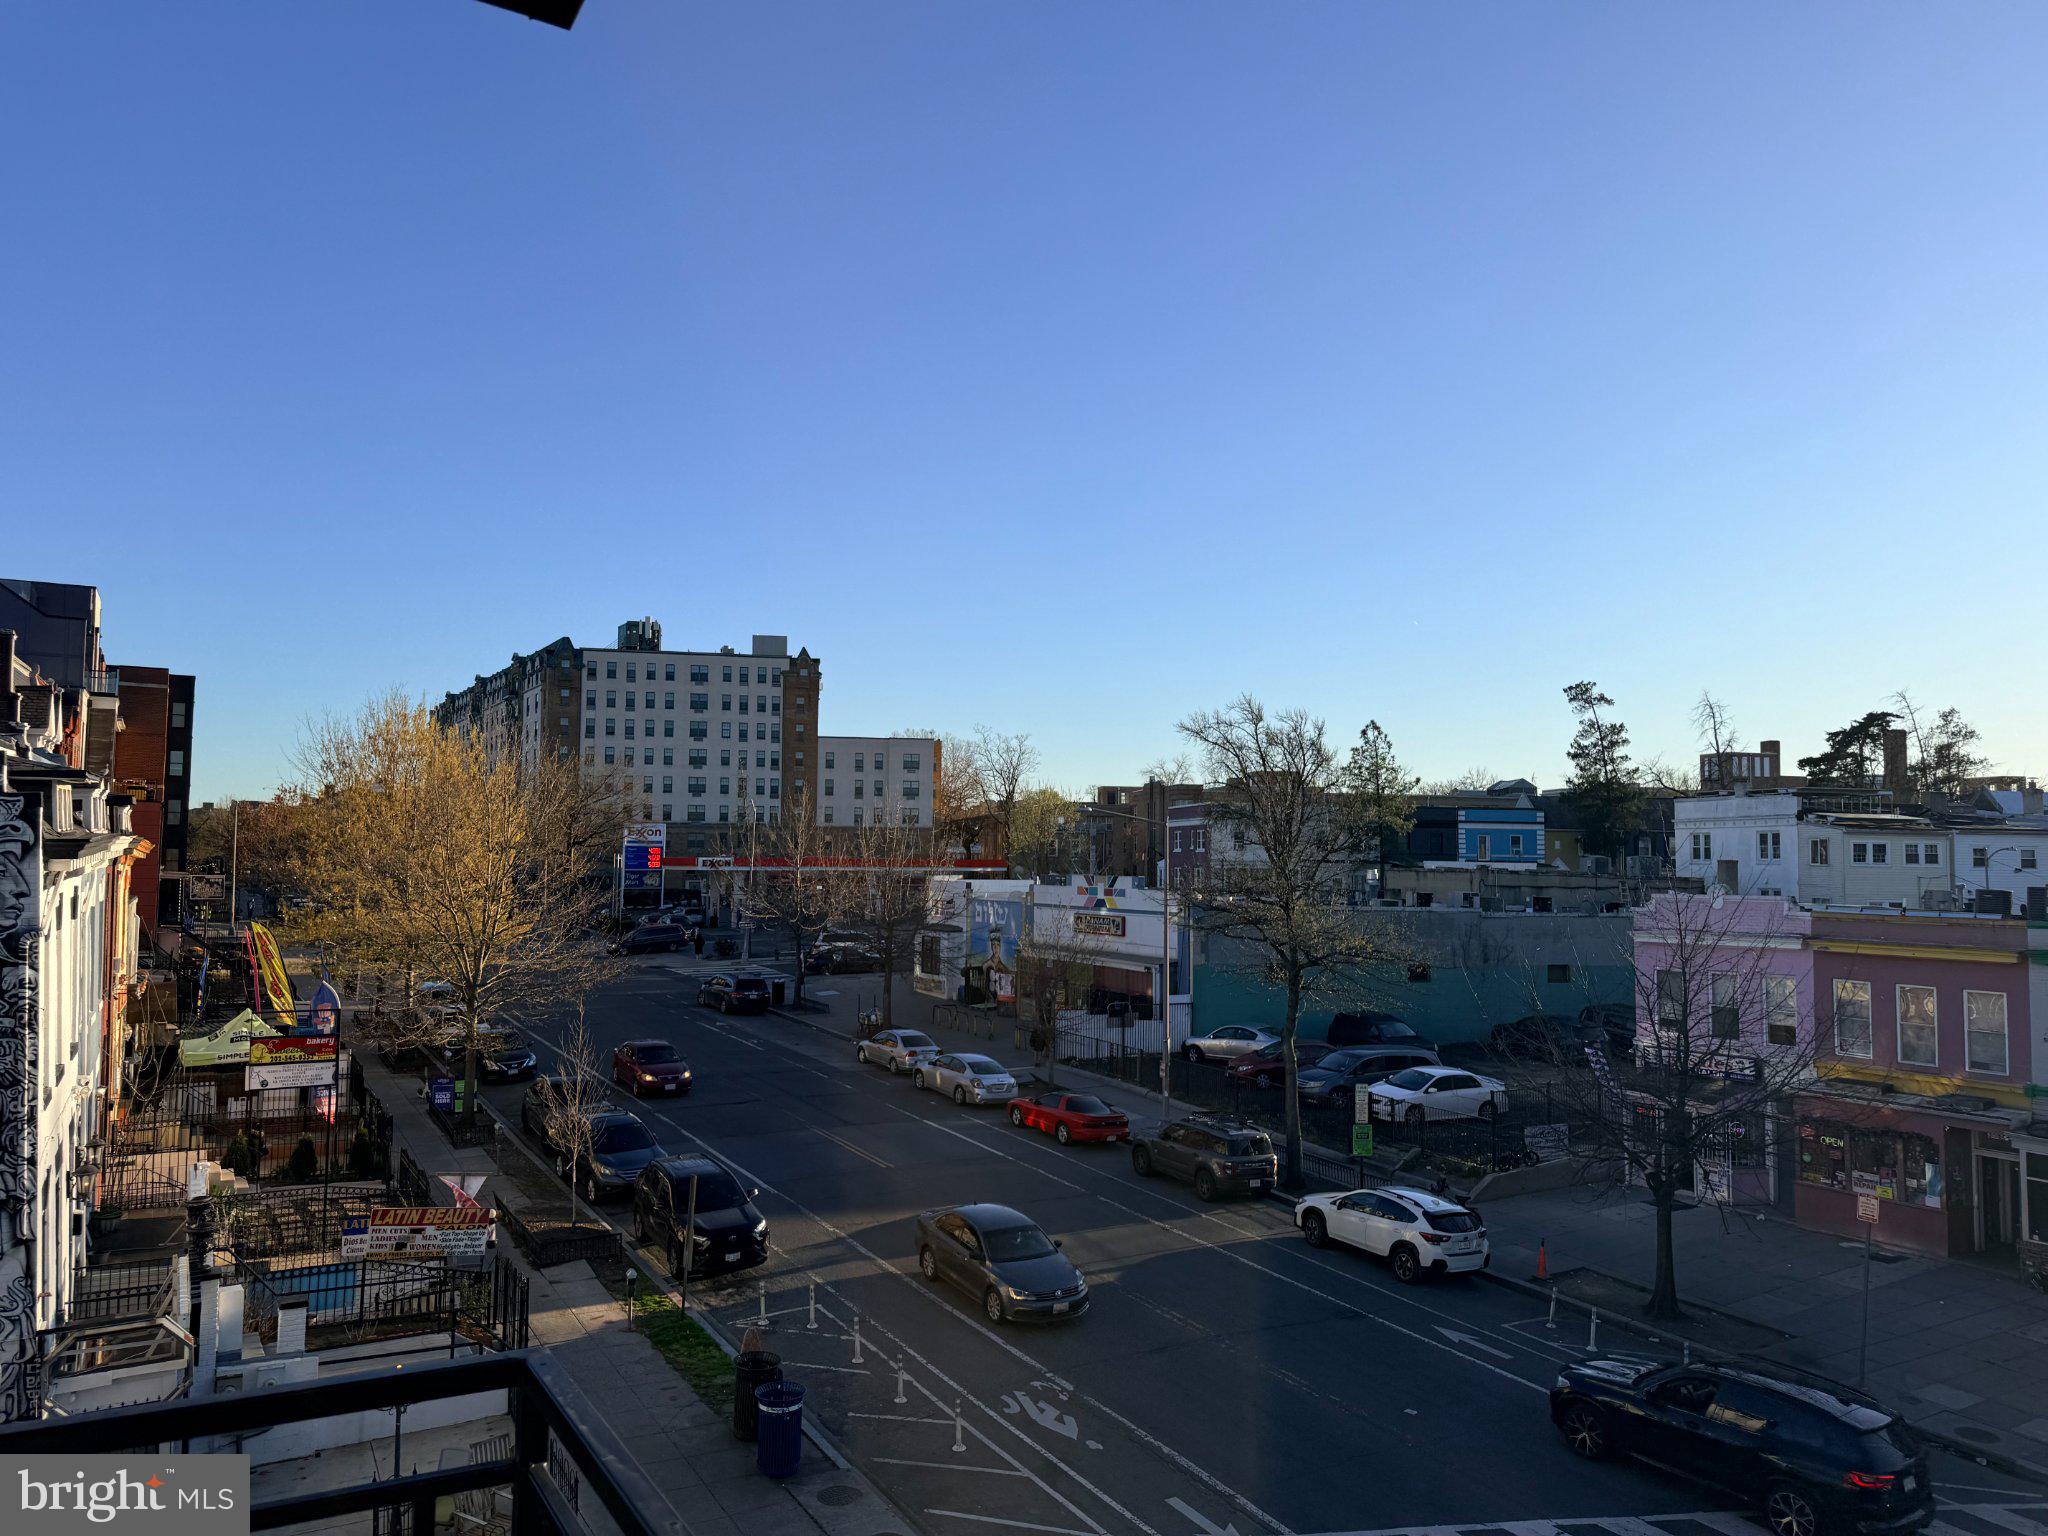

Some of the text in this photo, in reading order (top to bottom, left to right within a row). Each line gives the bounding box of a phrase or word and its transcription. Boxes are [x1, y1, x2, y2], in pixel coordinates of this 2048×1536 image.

[702, 859, 731, 868] EXXON
[306, 1037, 335, 1046] bakery
[1820, 1136, 1844, 1148] OPEN
[373, 1208, 485, 1224] LATIN BEAUTY
